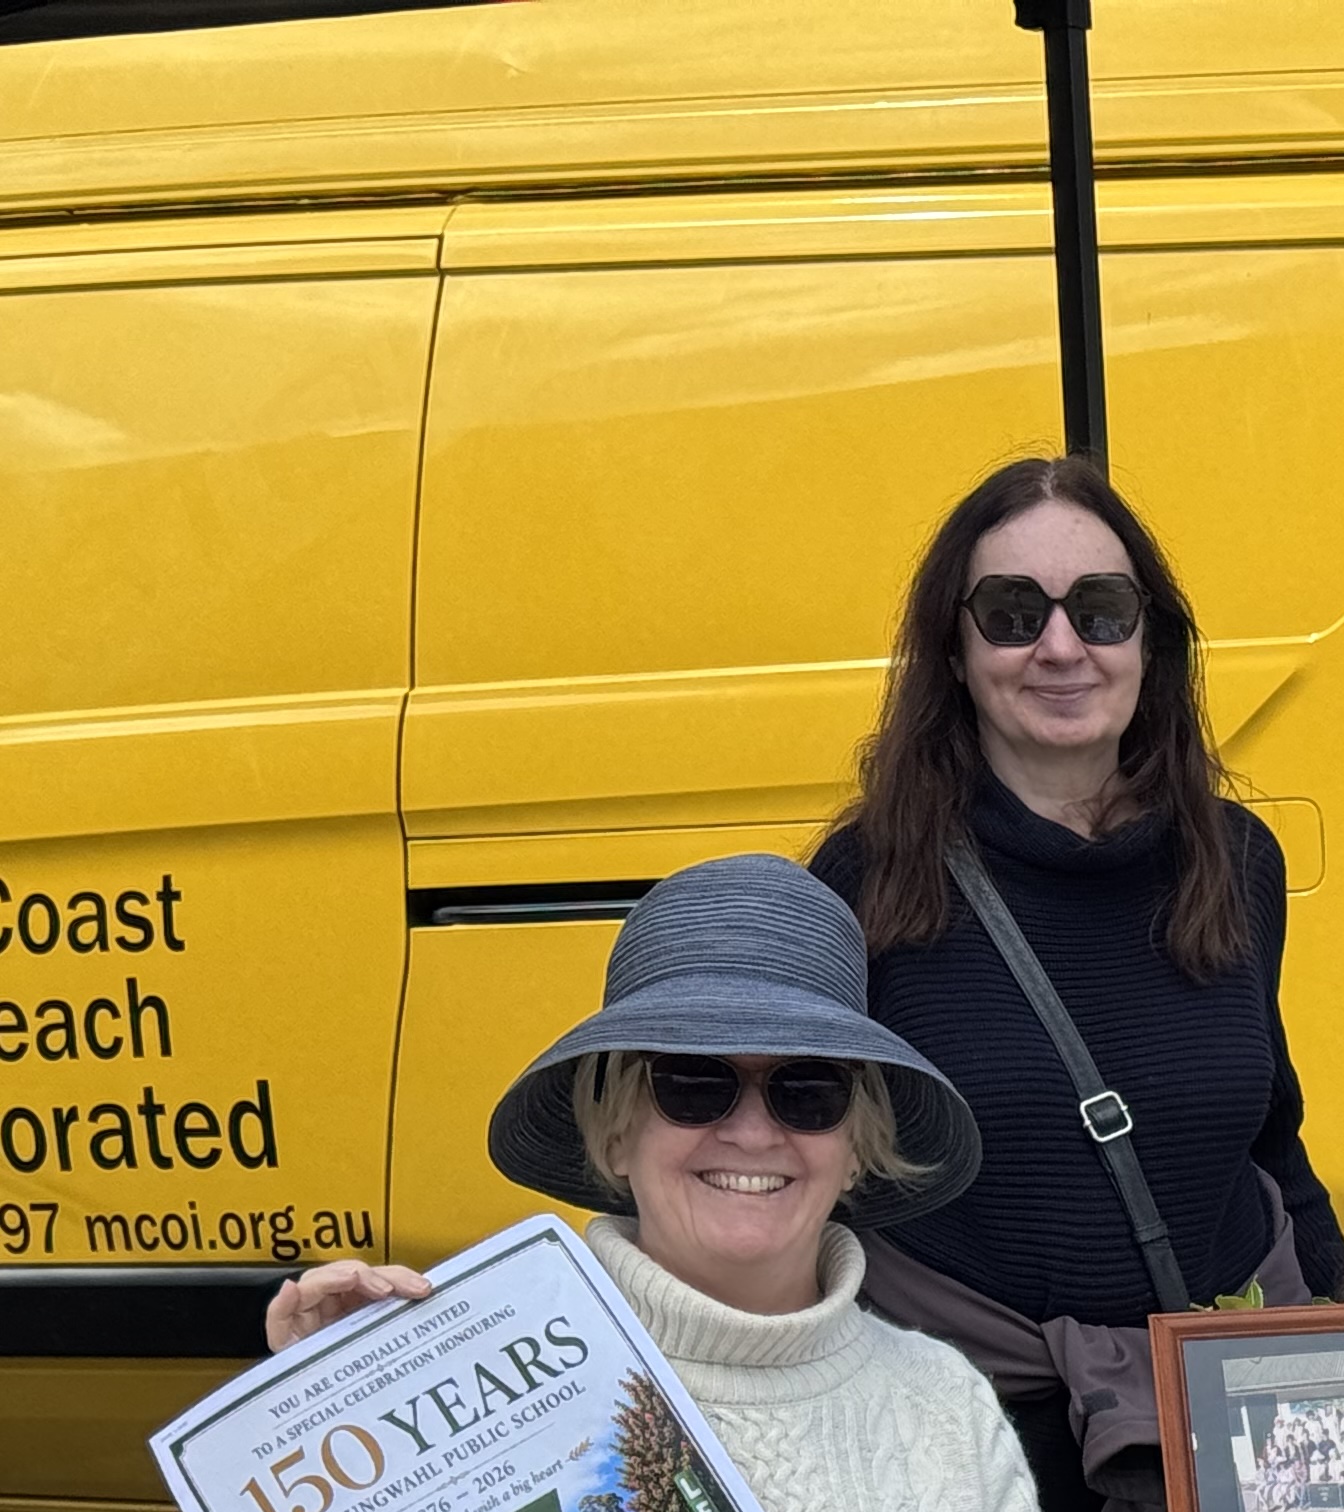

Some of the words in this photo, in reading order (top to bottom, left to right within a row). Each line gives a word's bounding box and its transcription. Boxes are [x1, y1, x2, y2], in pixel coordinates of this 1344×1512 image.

[0, 874, 186, 955] oast
[84, 1201, 375, 1262] mcoi.org.au
[251, 1442, 273, 1459] TO
[275, 1435, 287, 1448] A
[285, 1402, 344, 1440] SPECIAL
[343, 1348, 435, 1406] CELEBRATION
[434, 1304, 515, 1356] HONOURING
[268, 1394, 300, 1418] YOU
[303, 1376, 333, 1401] ARE
[333, 1331, 411, 1382] CORDIALLY
[411, 1300, 470, 1339] INVITED
[376, 1315, 591, 1461] YEARS
[441, 1420, 509, 1468] PUBLIC
[510, 1380, 586, 1429] SCHOOL
[472, 1459, 515, 1494] 2026
[509, 1479, 533, 1496] big
[529, 1459, 563, 1484] heart
